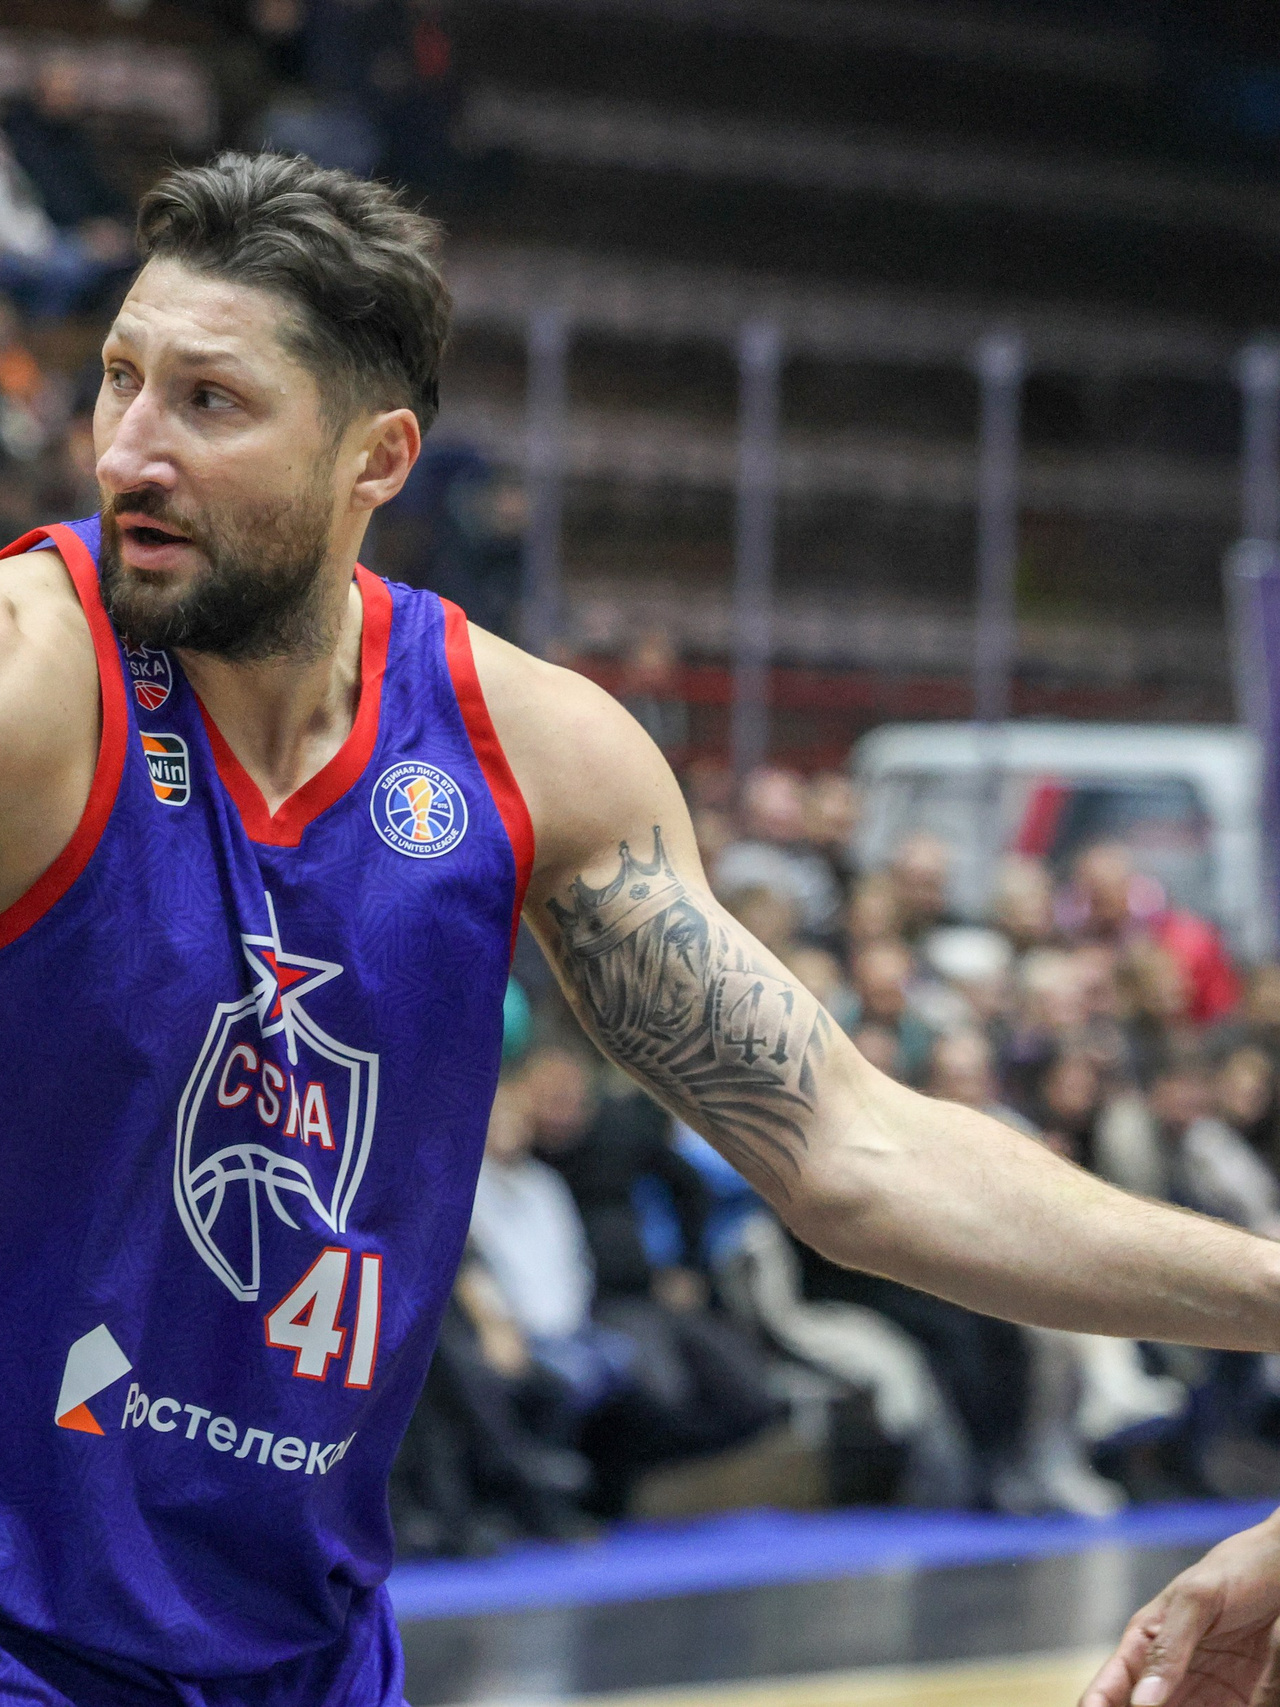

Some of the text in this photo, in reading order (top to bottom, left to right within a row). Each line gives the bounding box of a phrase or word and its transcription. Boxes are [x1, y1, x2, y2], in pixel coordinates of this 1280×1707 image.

[126, 660, 166, 677] SKA
[381, 766, 456, 795] ЕДИНАЯ ЛИГА ВТБ
[383, 825, 460, 853] VTB UNITED LEAGUE
[724, 980, 795, 1066] 41
[263, 1246, 383, 1391] 41
[121, 1382, 358, 1475] Ростелеко
